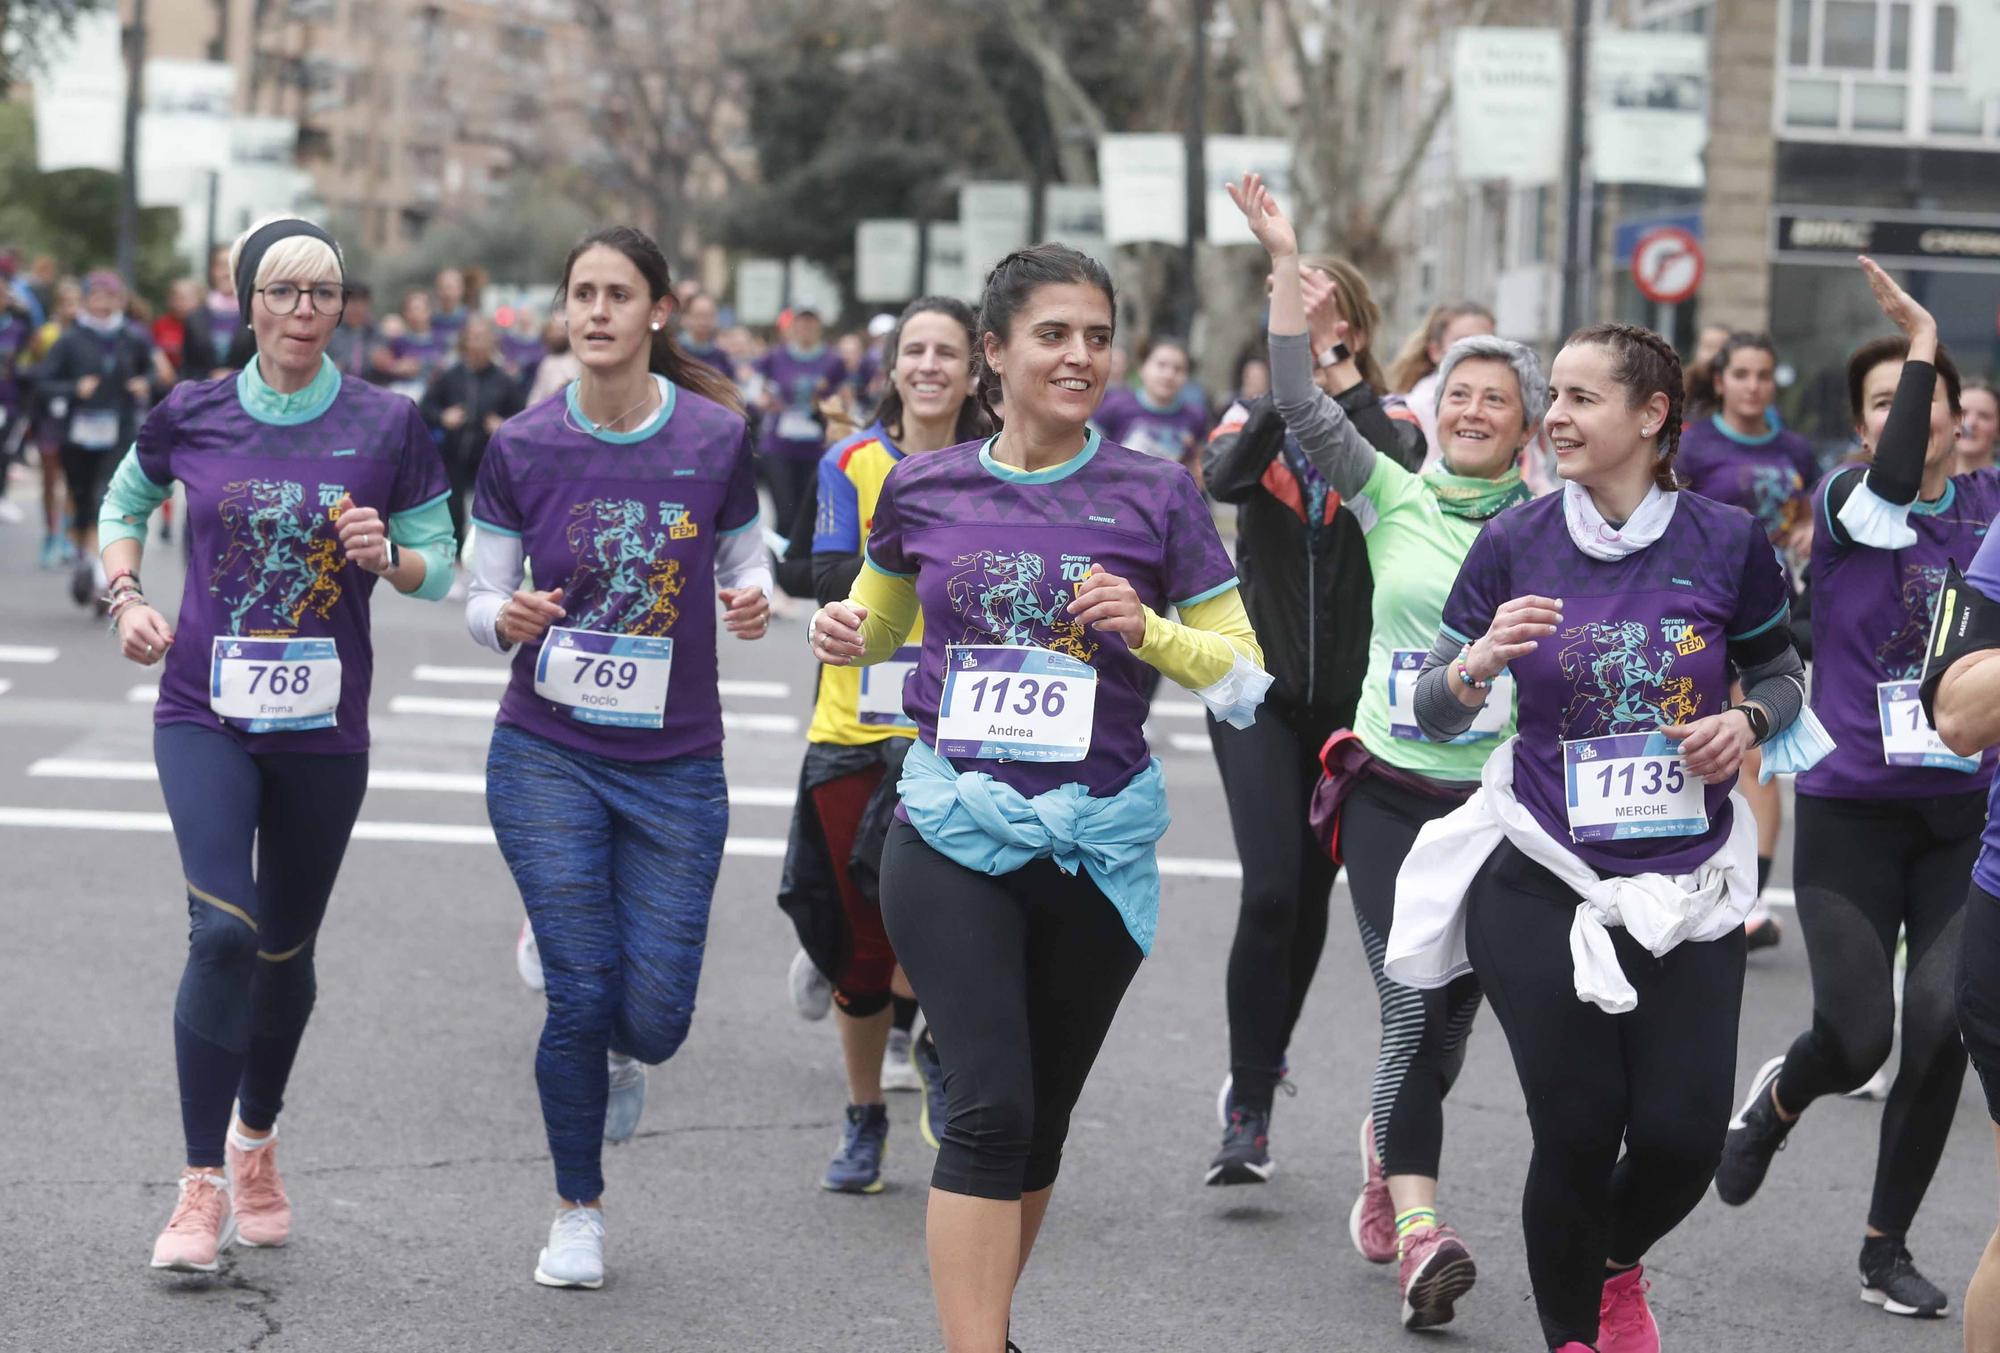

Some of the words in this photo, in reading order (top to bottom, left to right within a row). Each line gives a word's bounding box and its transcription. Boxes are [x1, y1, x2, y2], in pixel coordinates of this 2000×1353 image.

[659, 509, 690, 526] 10K
[672, 525, 697, 538] FEM
[1661, 624, 1694, 642] 10K
[1679, 637, 1704, 654] FEM
[248, 665, 311, 695] 768
[573, 656, 638, 690] 769
[971, 676, 1068, 717] 1136
[260, 704, 293, 713] Emma
[987, 724, 1033, 738] Andrea
[1596, 760, 1685, 798] 1135
[1615, 804, 1668, 817] MERCHE
